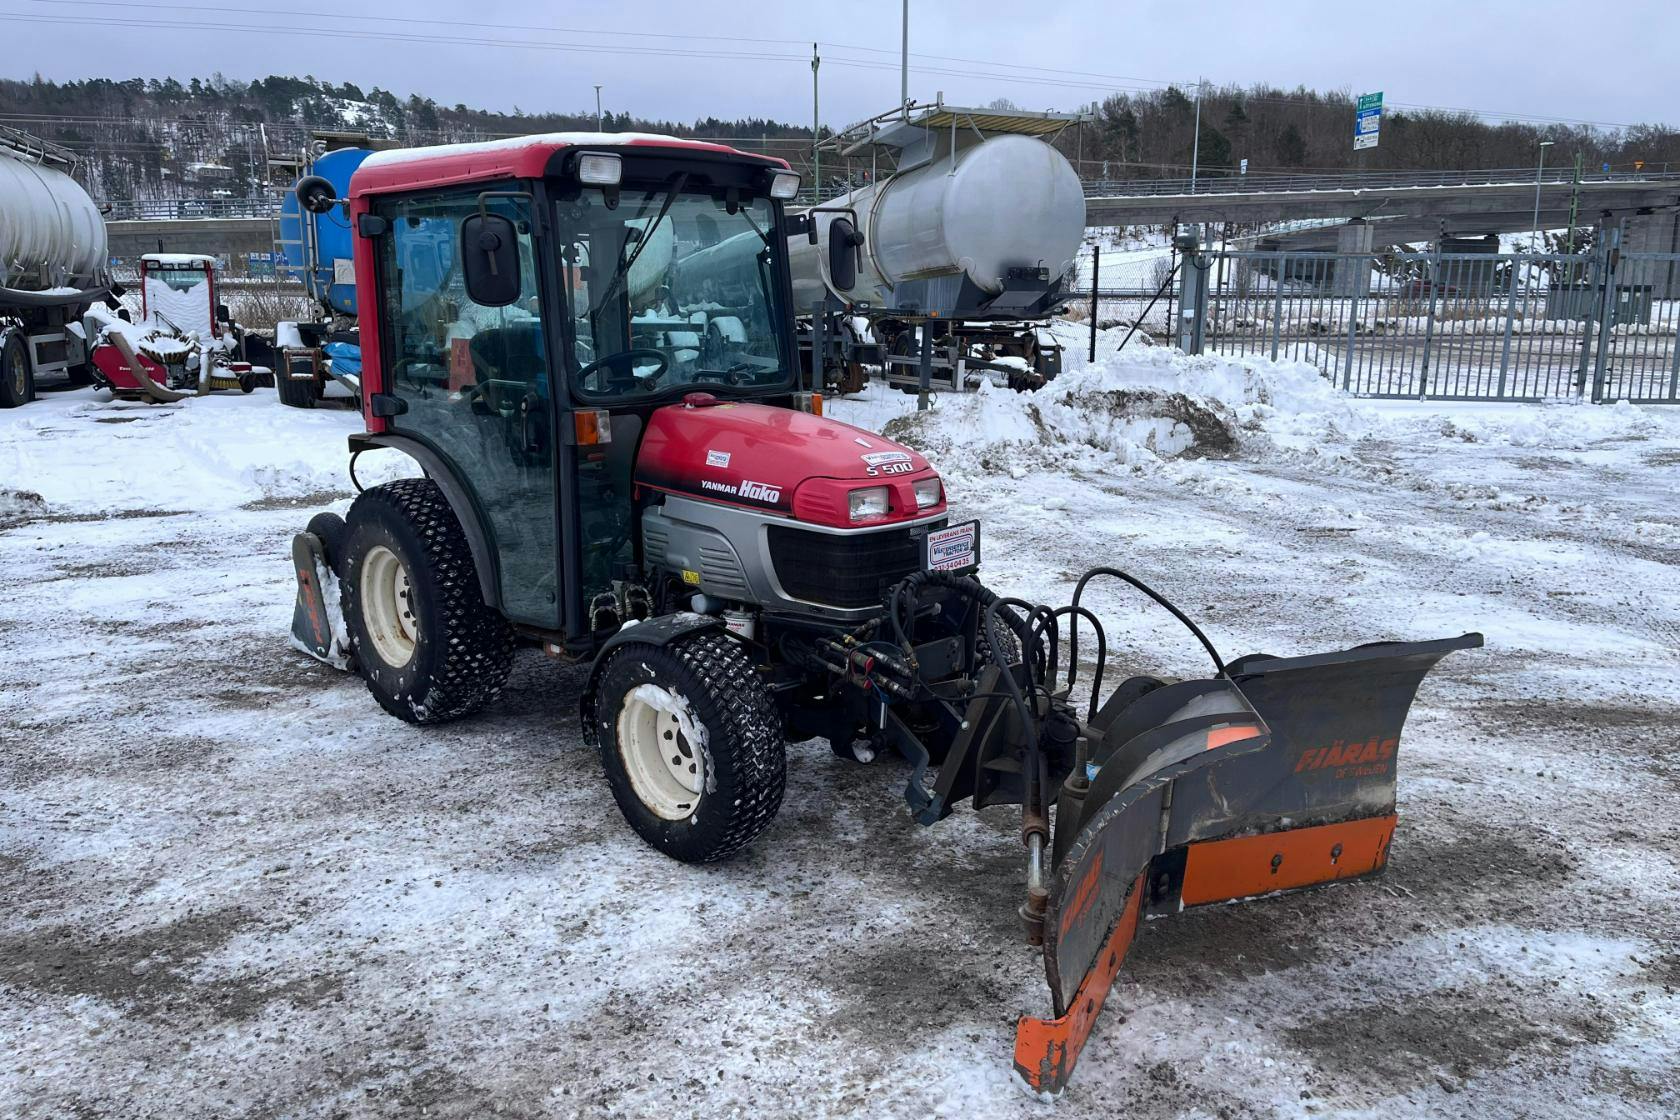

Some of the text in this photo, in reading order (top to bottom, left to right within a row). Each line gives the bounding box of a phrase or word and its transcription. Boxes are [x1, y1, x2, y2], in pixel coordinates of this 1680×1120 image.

[866, 462, 914, 477] S 500
[701, 479, 783, 504] YANMAR Hako
[1295, 736, 1397, 773] FJÄRÅS
